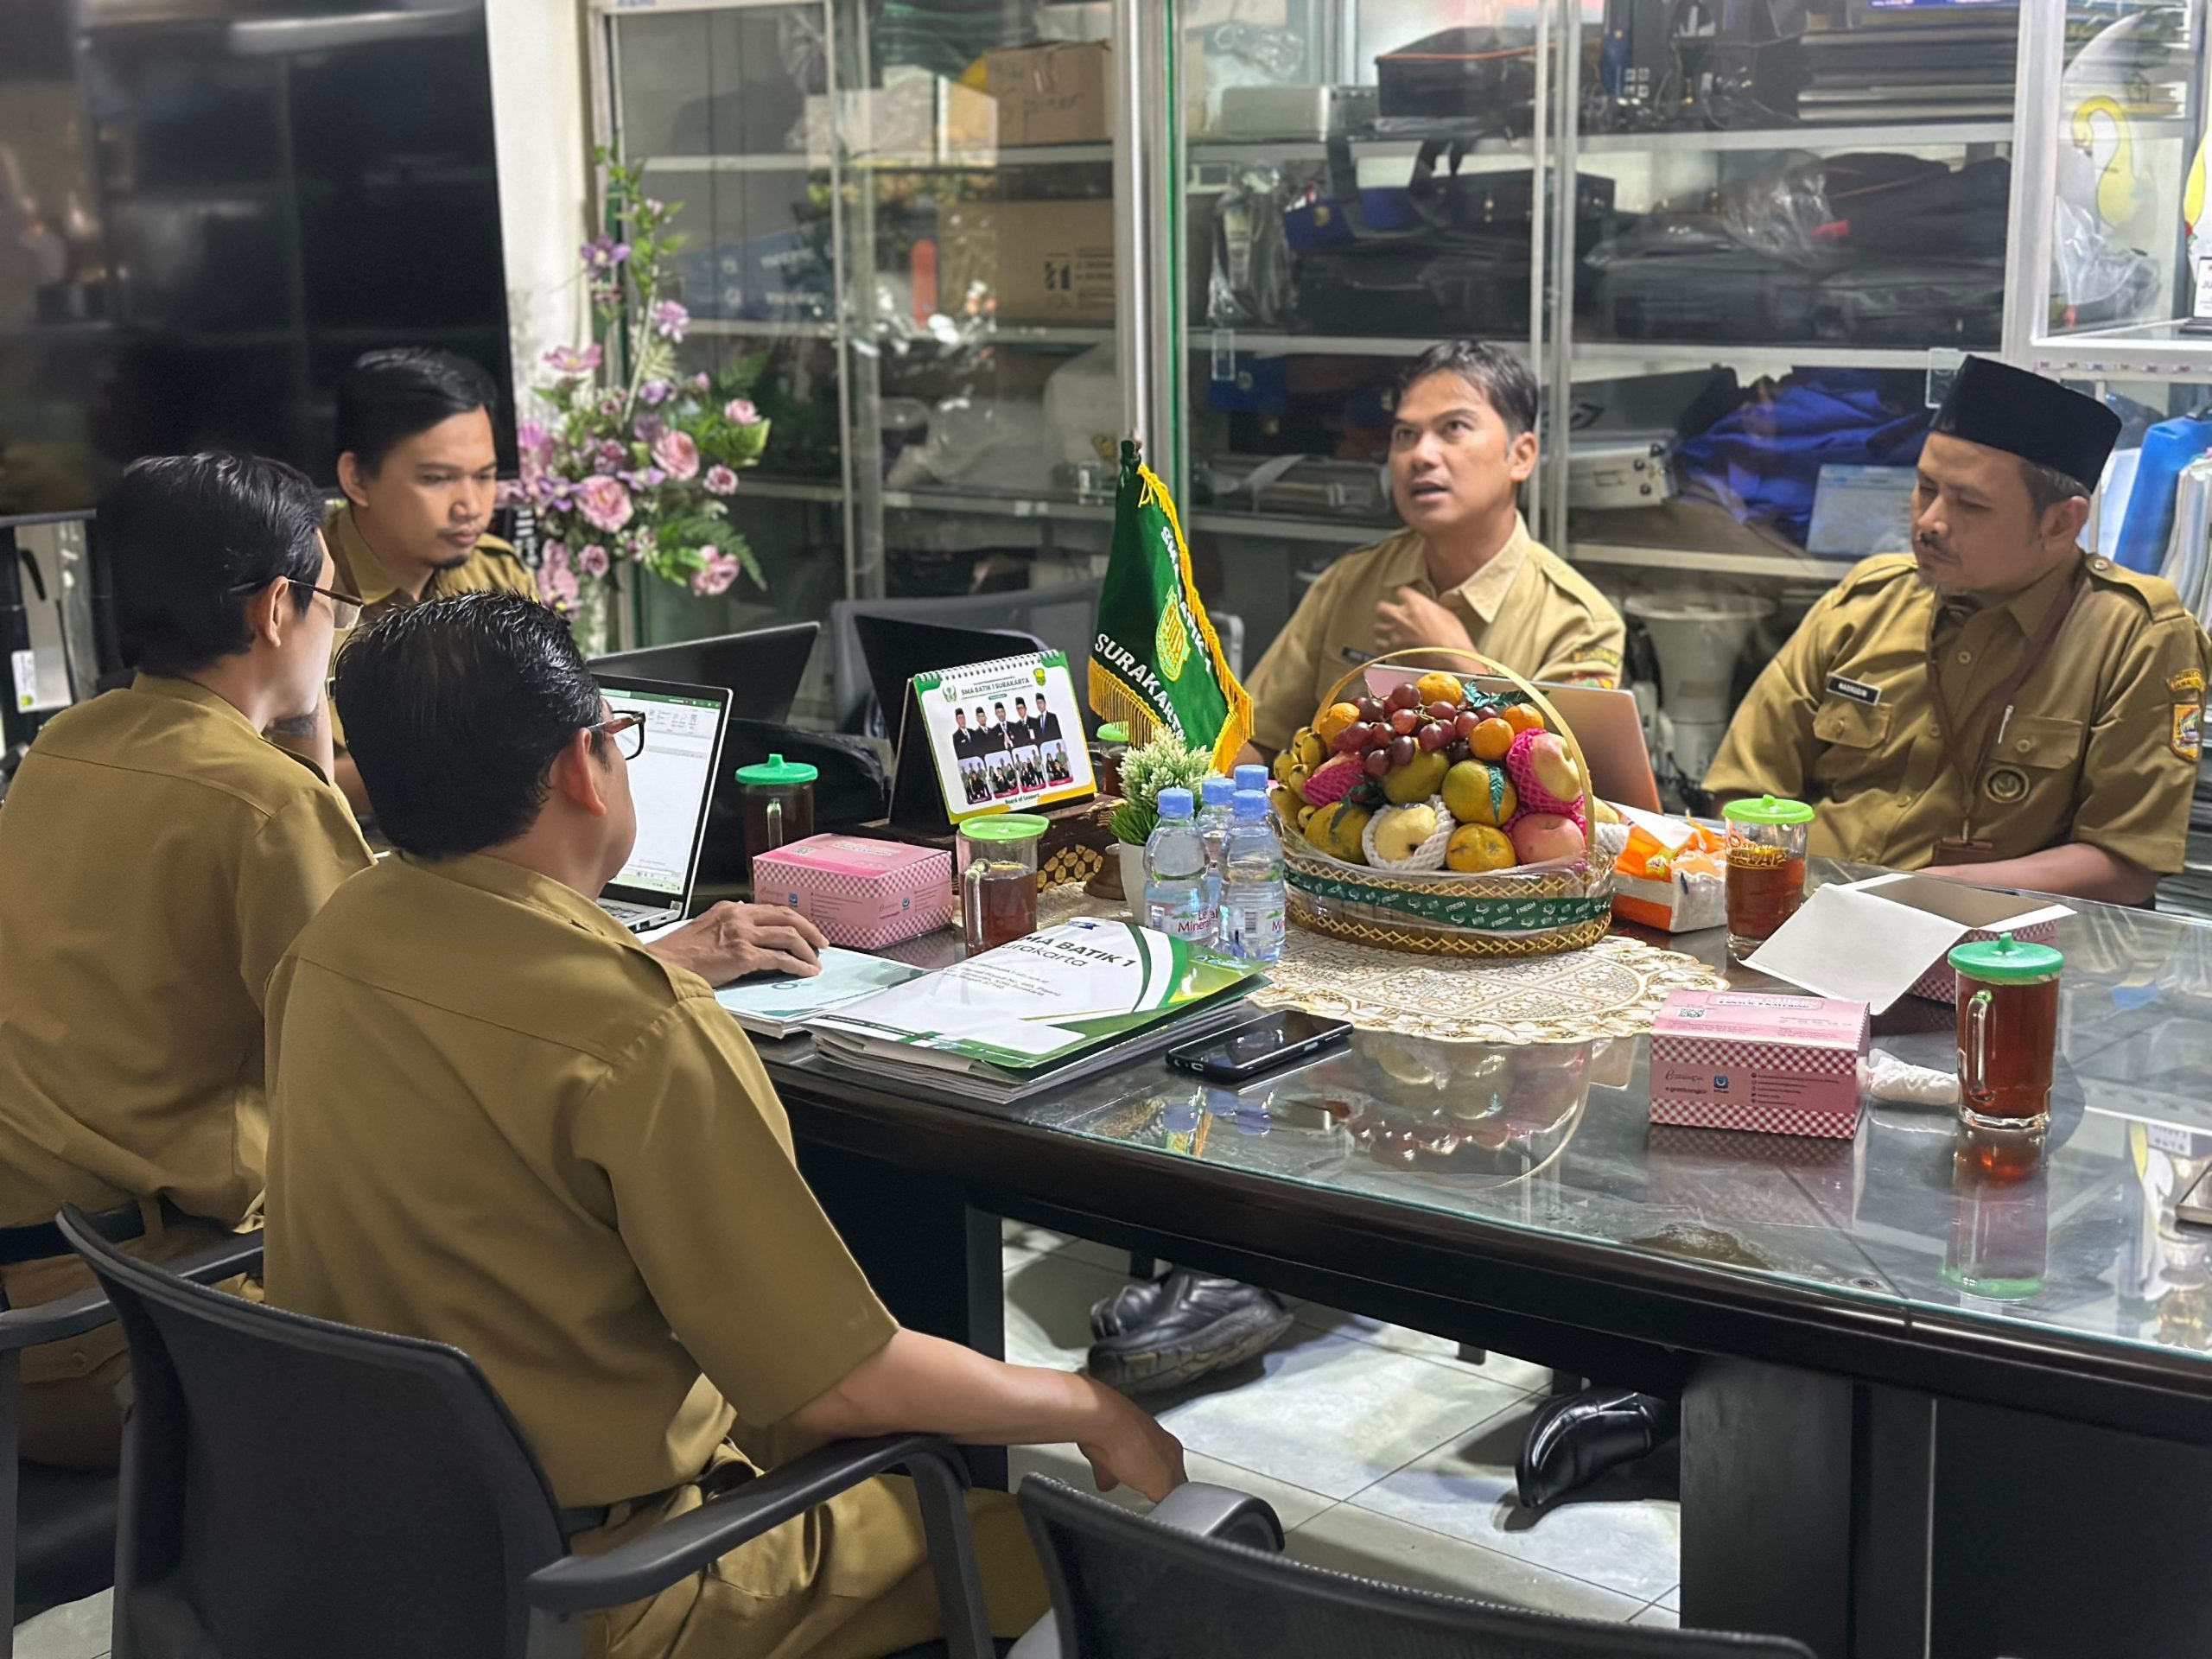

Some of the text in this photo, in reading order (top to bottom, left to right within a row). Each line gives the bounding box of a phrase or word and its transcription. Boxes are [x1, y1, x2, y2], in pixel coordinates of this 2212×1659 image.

[975, 684, 992, 693] BATIK
[995, 677, 1030, 690] SURAKARTA
[1094, 632, 1185, 740] SURAKARTA
[1445, 899, 1467, 912] FRESH
[1516, 901, 1536, 915] FRESH
[1001, 944, 1089, 967] urakarta
[1019, 936, 1055, 945] MA
[1055, 941, 1123, 963] BATIK
